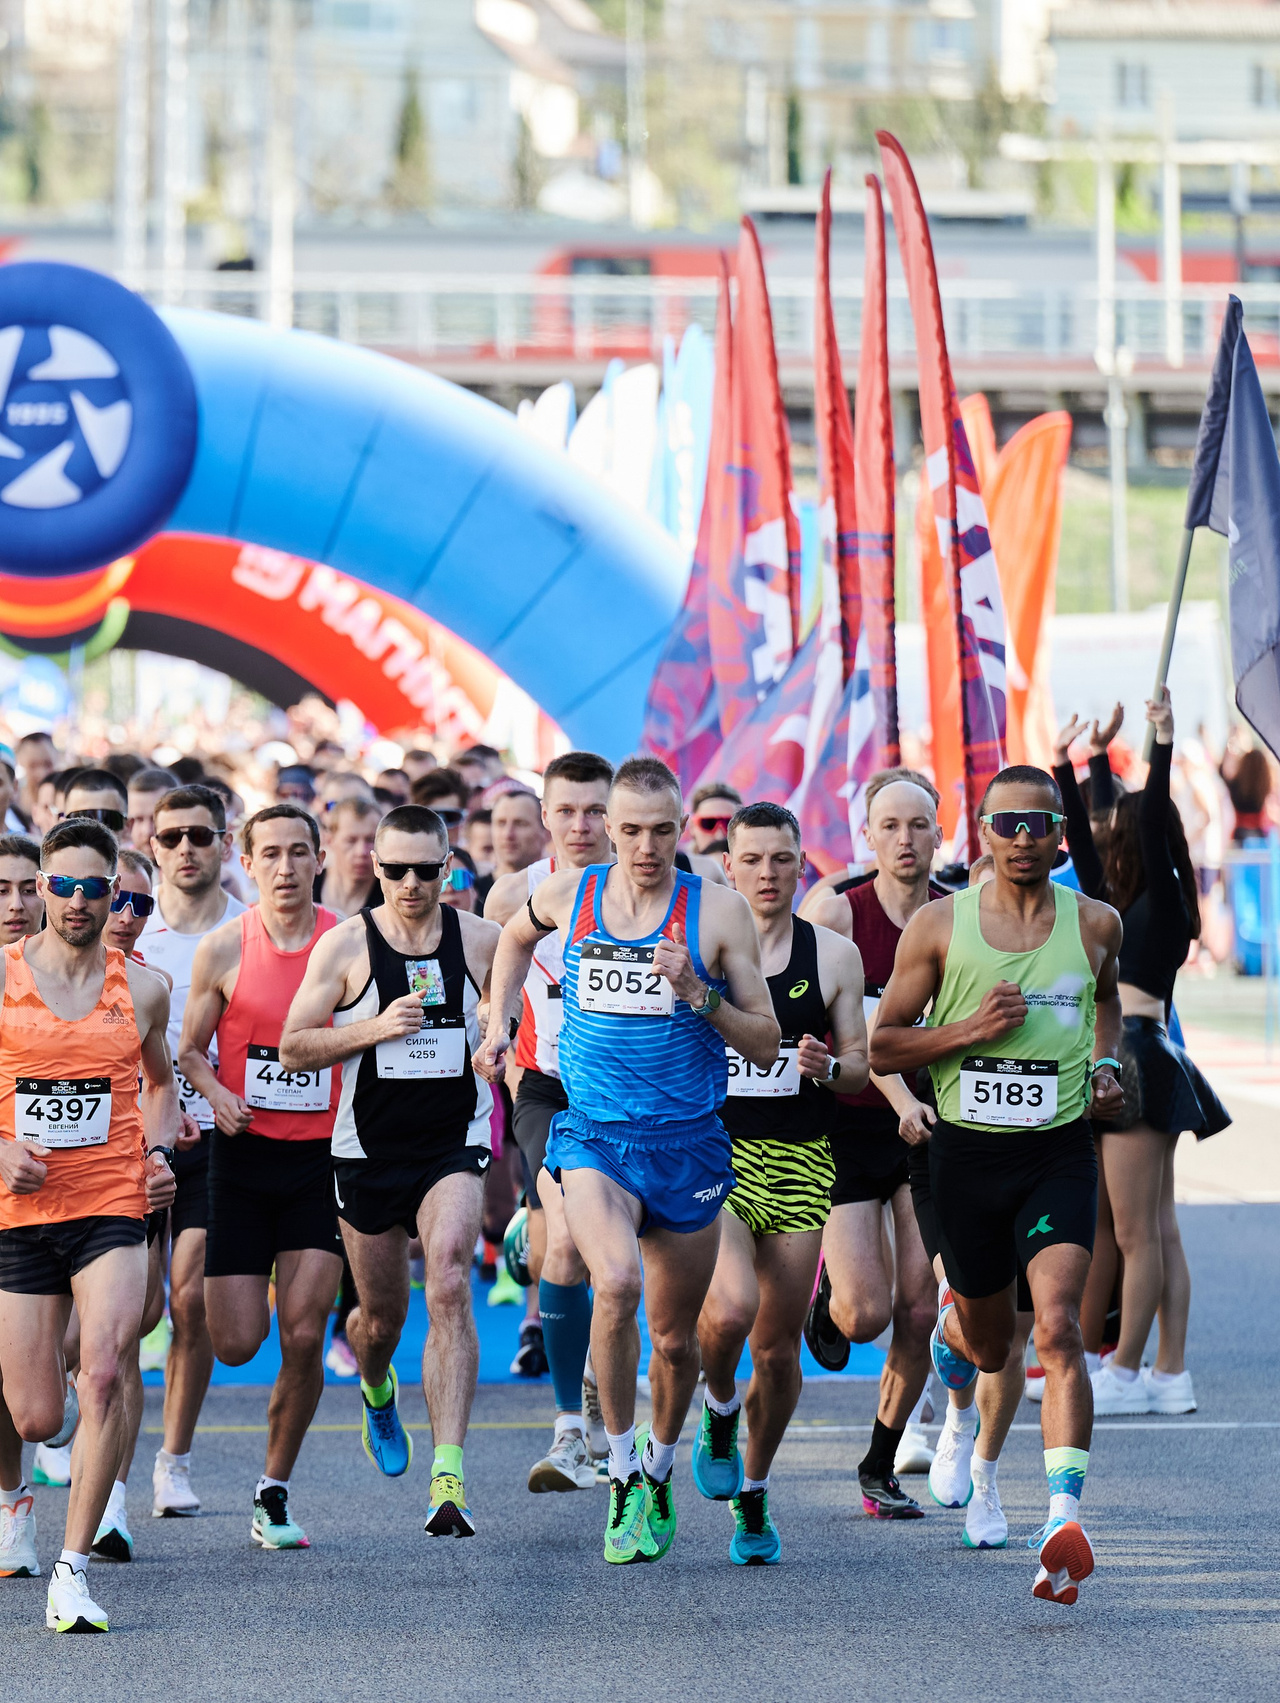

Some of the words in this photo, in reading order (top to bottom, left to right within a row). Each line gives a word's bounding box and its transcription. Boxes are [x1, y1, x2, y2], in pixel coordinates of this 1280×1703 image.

[593, 947, 601, 955] 10
[612, 951, 638, 959] SOCHI
[588, 968, 662, 996] 5052
[102, 1016, 129, 1025] adidas
[405, 1038, 438, 1046] СИЛИН
[260, 1049, 268, 1057] 10
[408, 1050, 436, 1059] 4259
[256, 1064, 320, 1088] 4451
[973, 1080, 1043, 1107] 5183
[25, 1097, 101, 1122] 4397
[48, 1122, 79, 1130] ЕВГЕНИЙ
[695, 1183, 724, 1203] RAV
